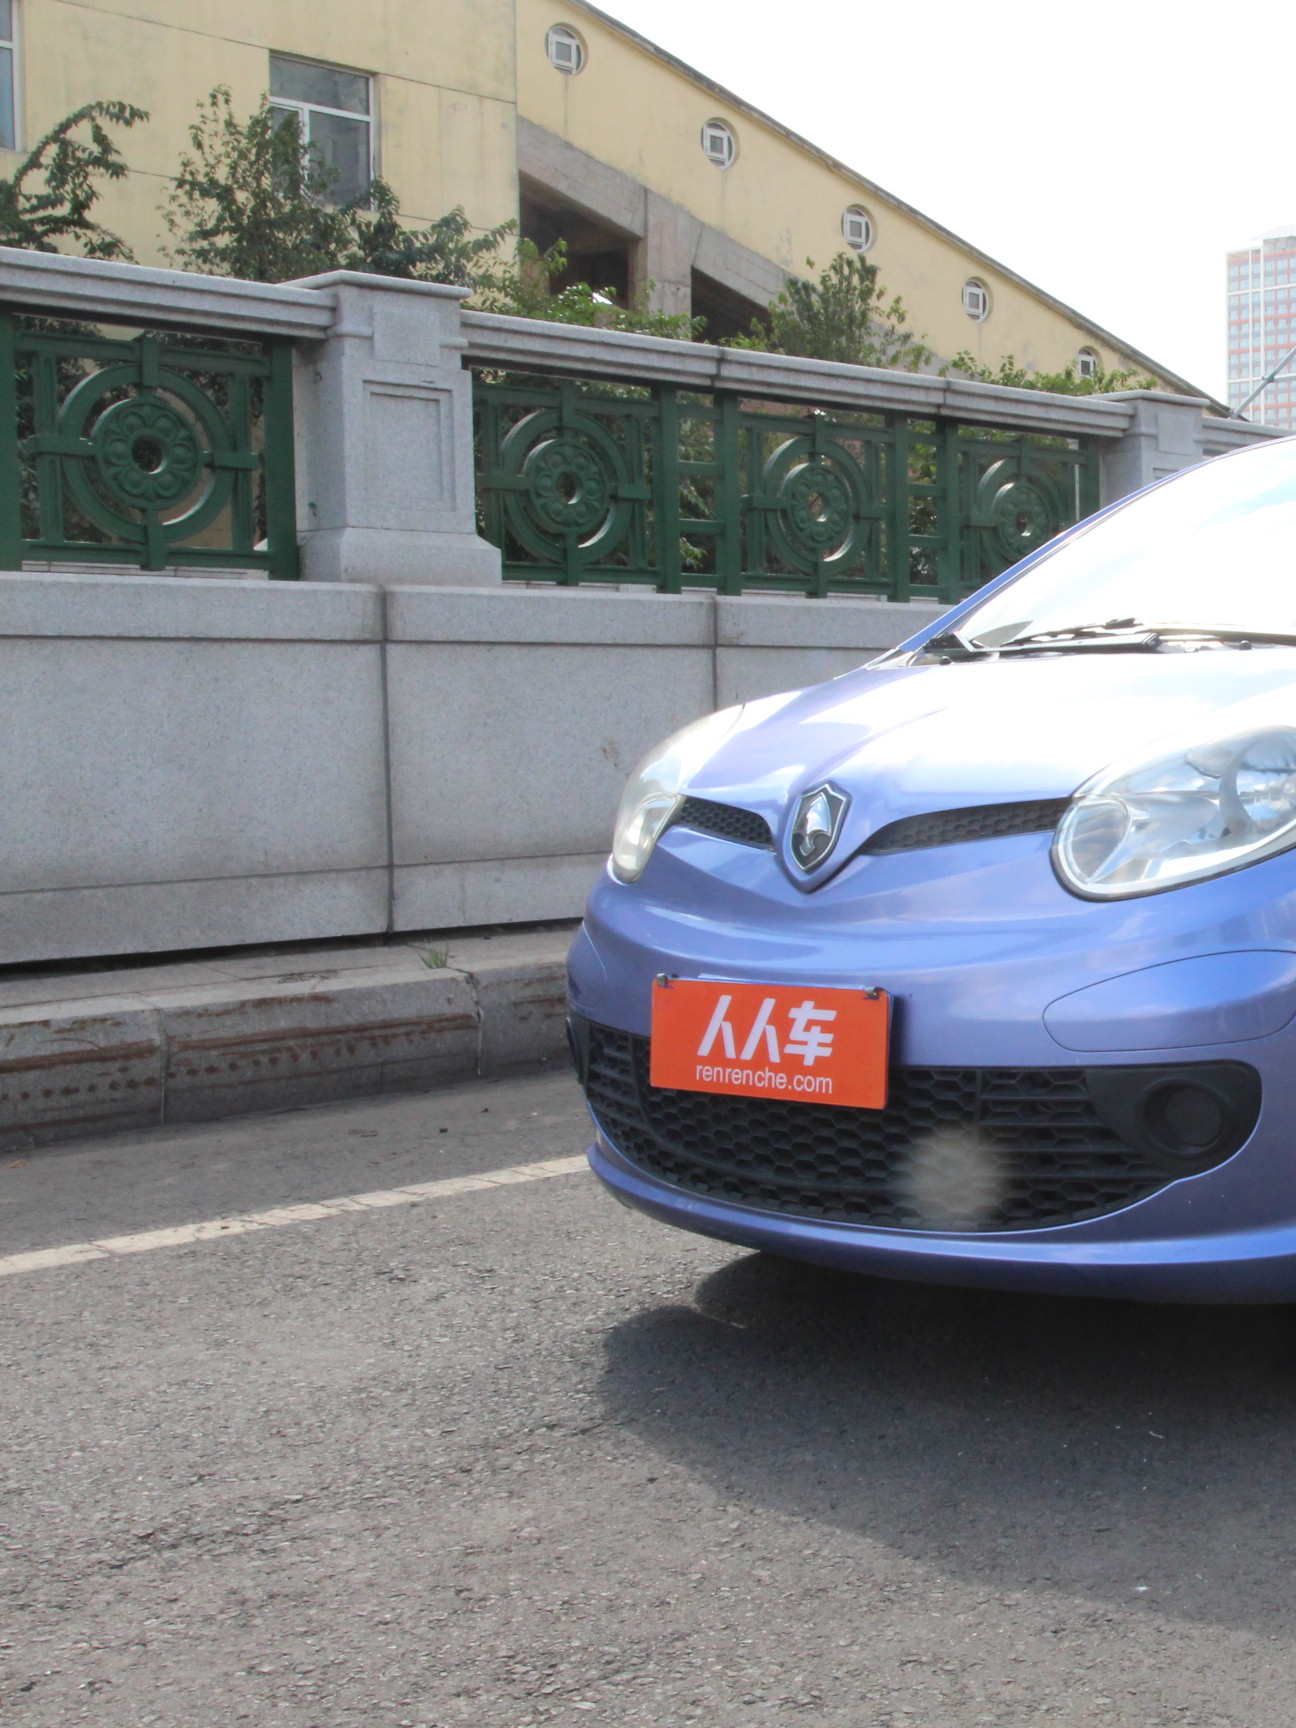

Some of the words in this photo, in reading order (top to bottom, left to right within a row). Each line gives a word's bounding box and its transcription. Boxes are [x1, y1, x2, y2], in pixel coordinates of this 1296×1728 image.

[697, 995, 837, 1066] 人人车
[696, 1065, 833, 1094] renrenche.com
